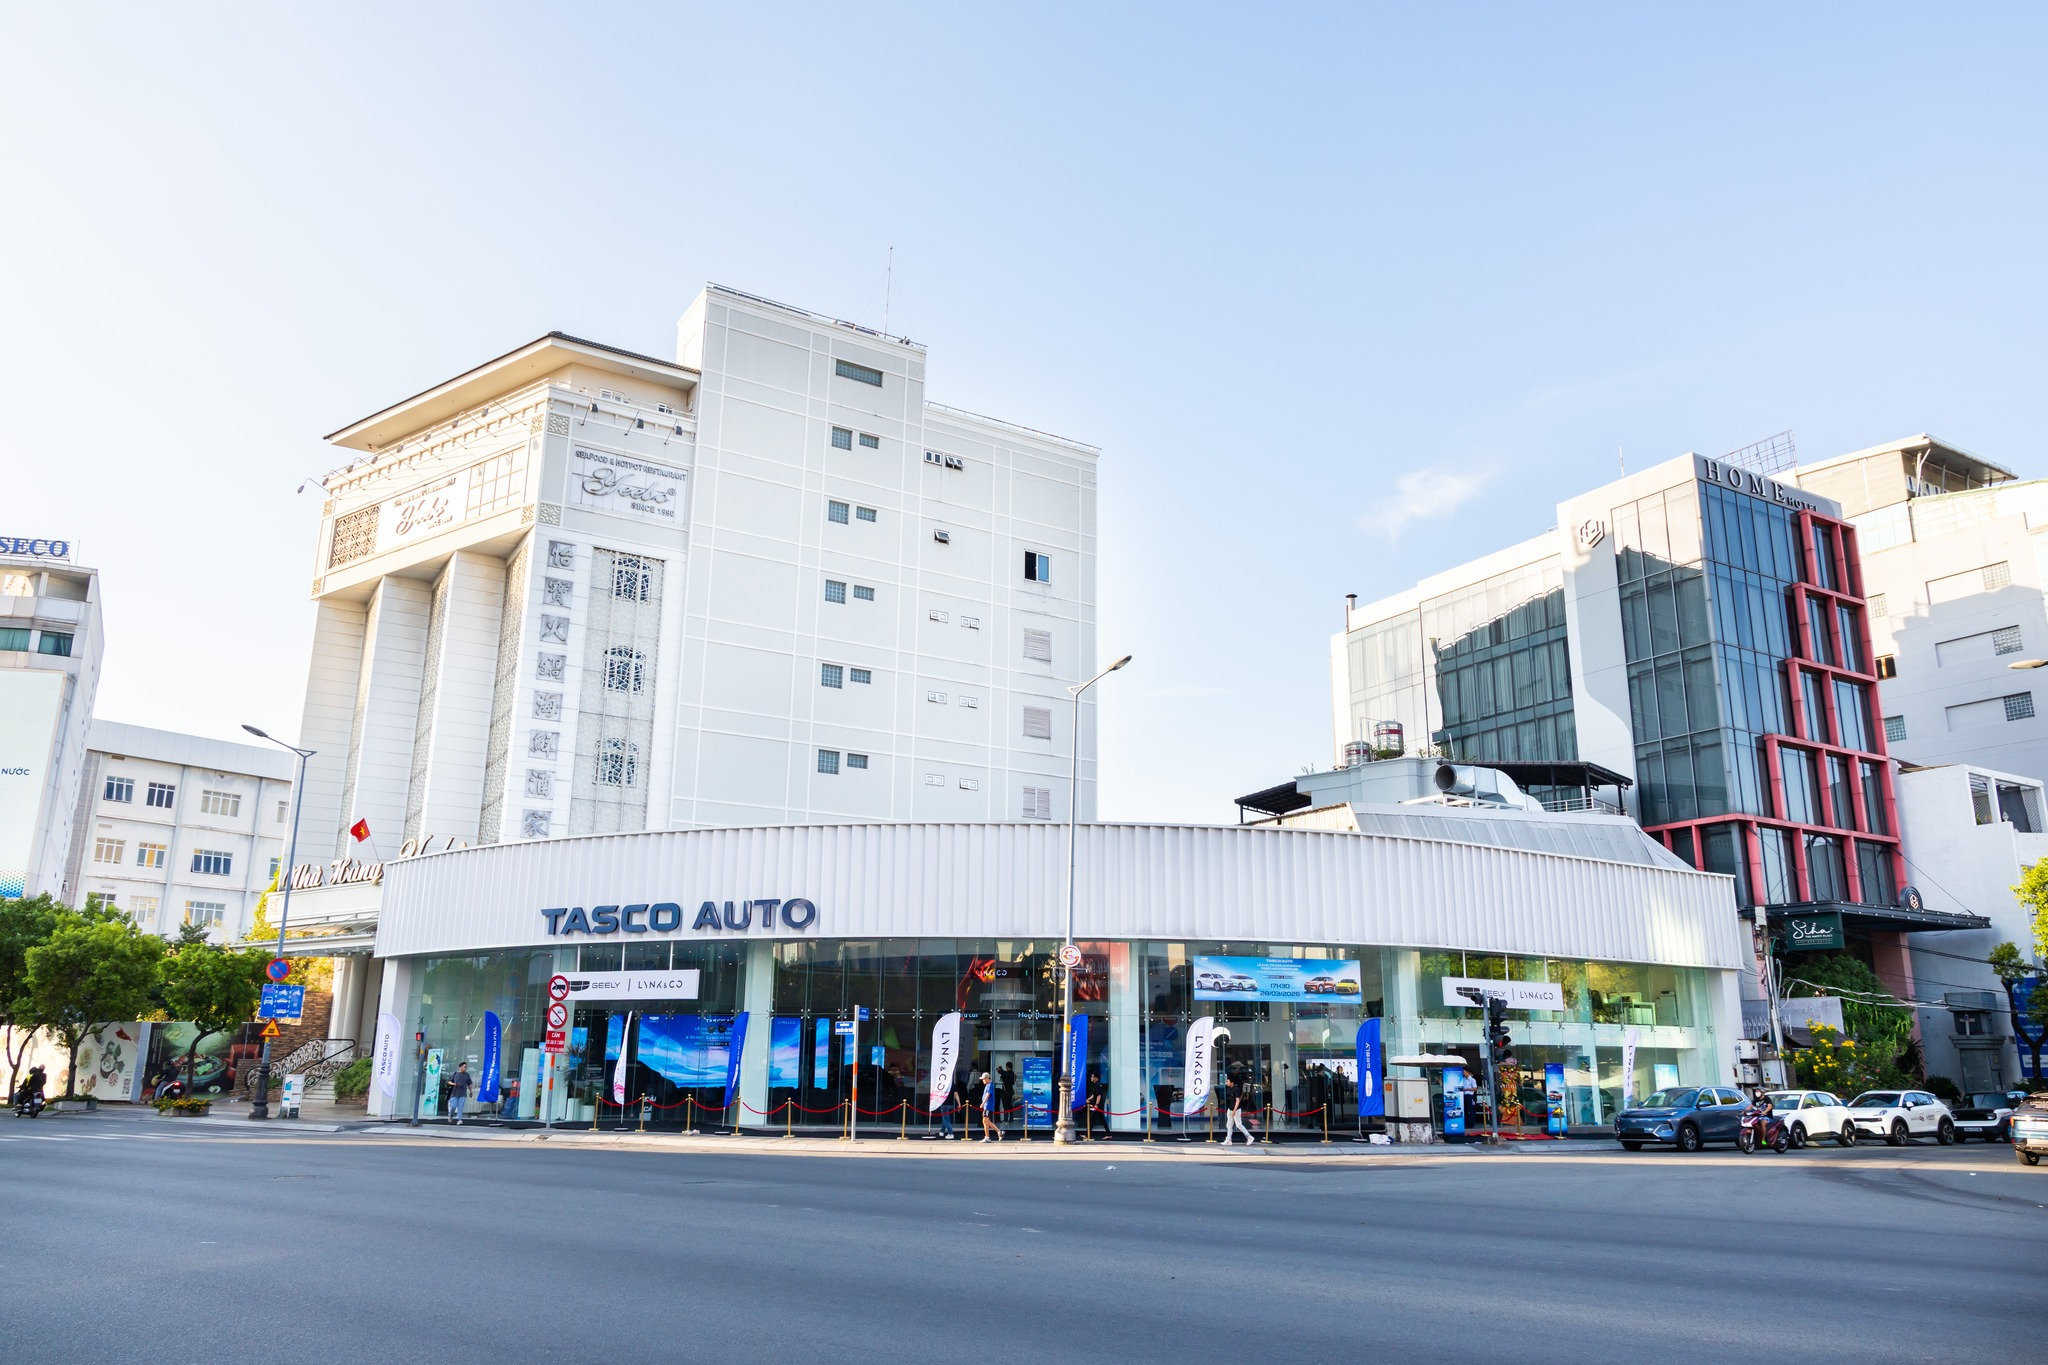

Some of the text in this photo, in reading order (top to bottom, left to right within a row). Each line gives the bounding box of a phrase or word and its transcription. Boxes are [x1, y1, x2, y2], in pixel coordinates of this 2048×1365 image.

[575, 450, 608, 464] SEAFOOD
[615, 459, 642, 472] HOTPOT
[643, 465, 687, 481] RESTAURANT
[1705, 459, 1785, 504] HOME
[631, 502, 655, 514] SINCE
[1, 766, 30, 776] NƯỚC
[283, 857, 385, 890] Nhà Hàng
[540, 897, 816, 936] TASCO AUTO
[591, 981, 621, 989] GEELY
[638, 980, 683, 989] LYNK&CO
[1484, 989, 1506, 999] EELY
[937, 1032, 950, 1091] LYNK&CO
[1193, 1035, 1204, 1096] LYNK&CO
